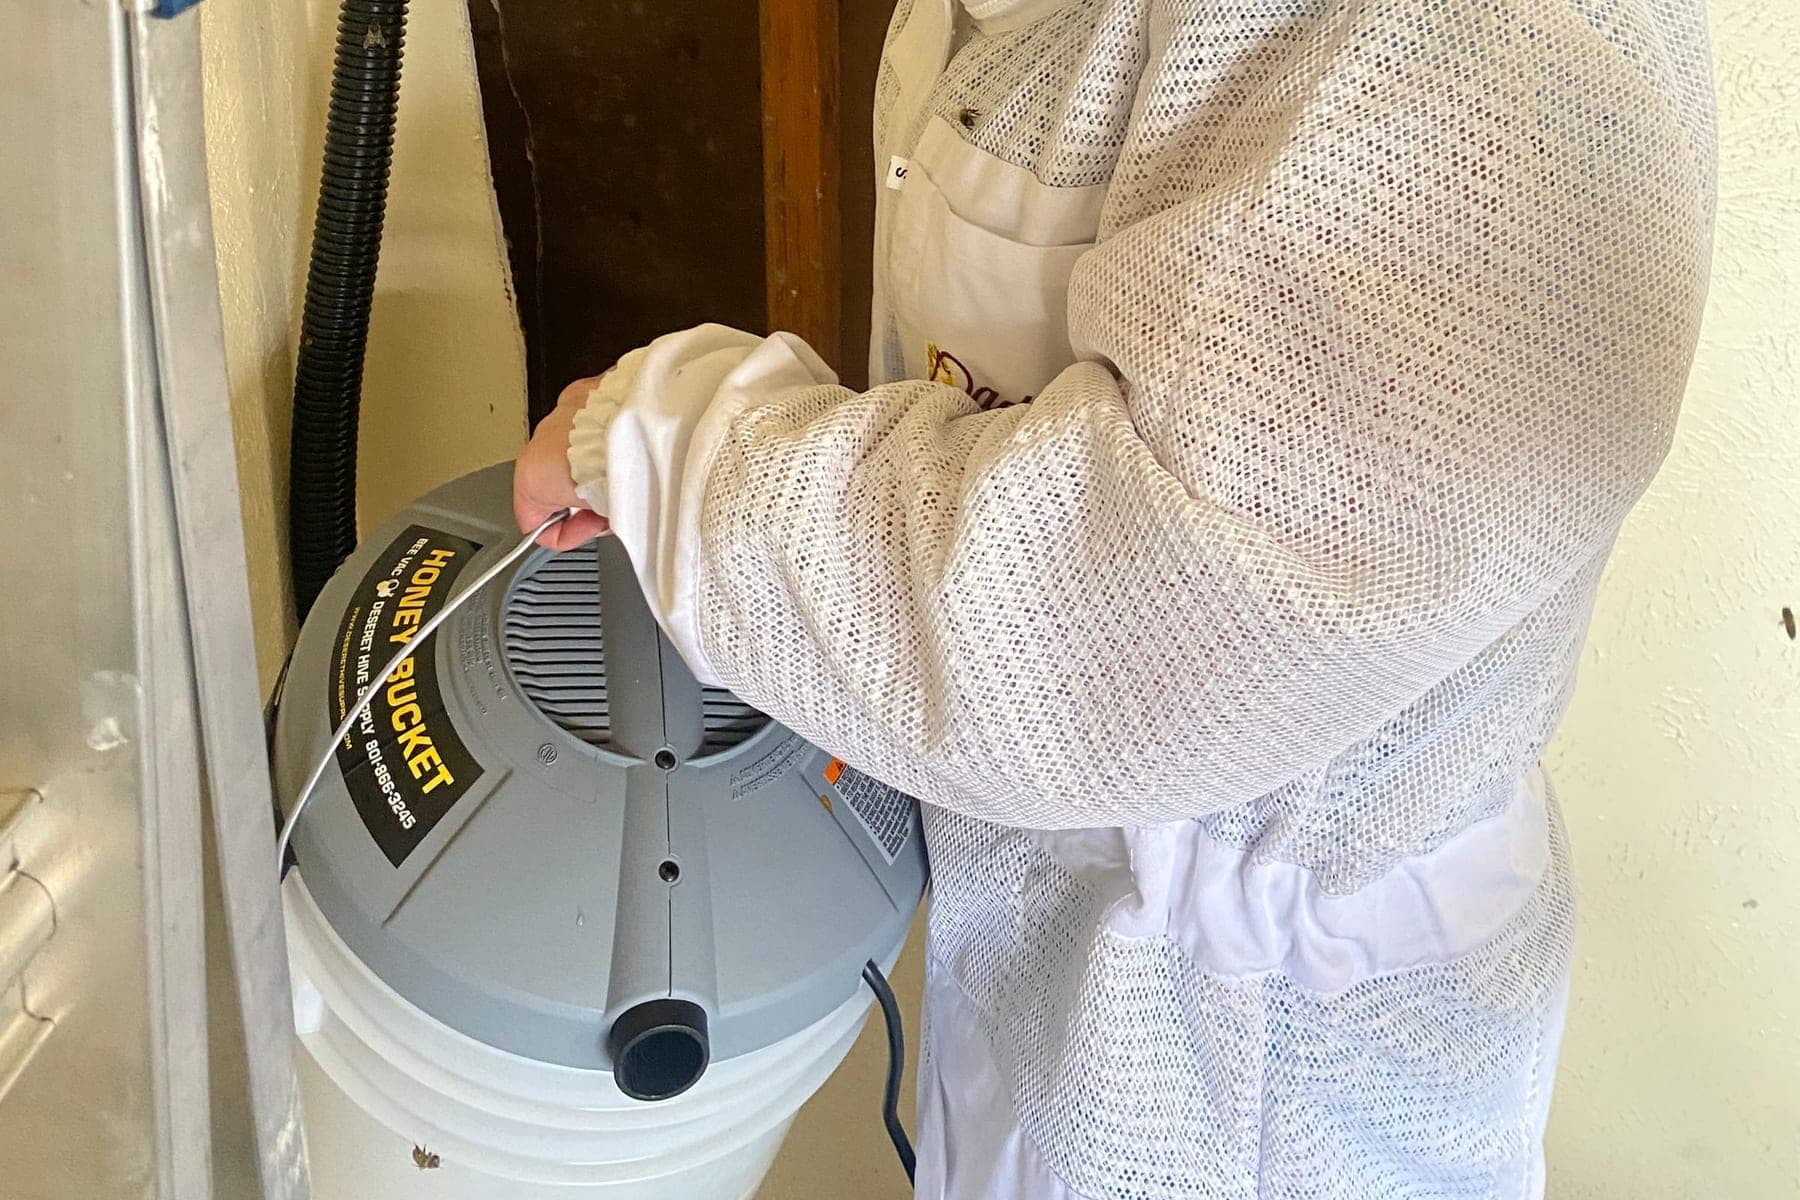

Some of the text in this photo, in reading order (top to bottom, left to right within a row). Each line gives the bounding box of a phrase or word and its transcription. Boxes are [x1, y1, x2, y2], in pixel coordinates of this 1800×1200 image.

[391, 557, 410, 576] VAC
[406, 538, 429, 555] BEE
[359, 601, 385, 652] DESERET
[356, 654, 371, 685] HIVE
[387, 549, 456, 795] HONEY BUCKET
[356, 685, 375, 735] SPPLY
